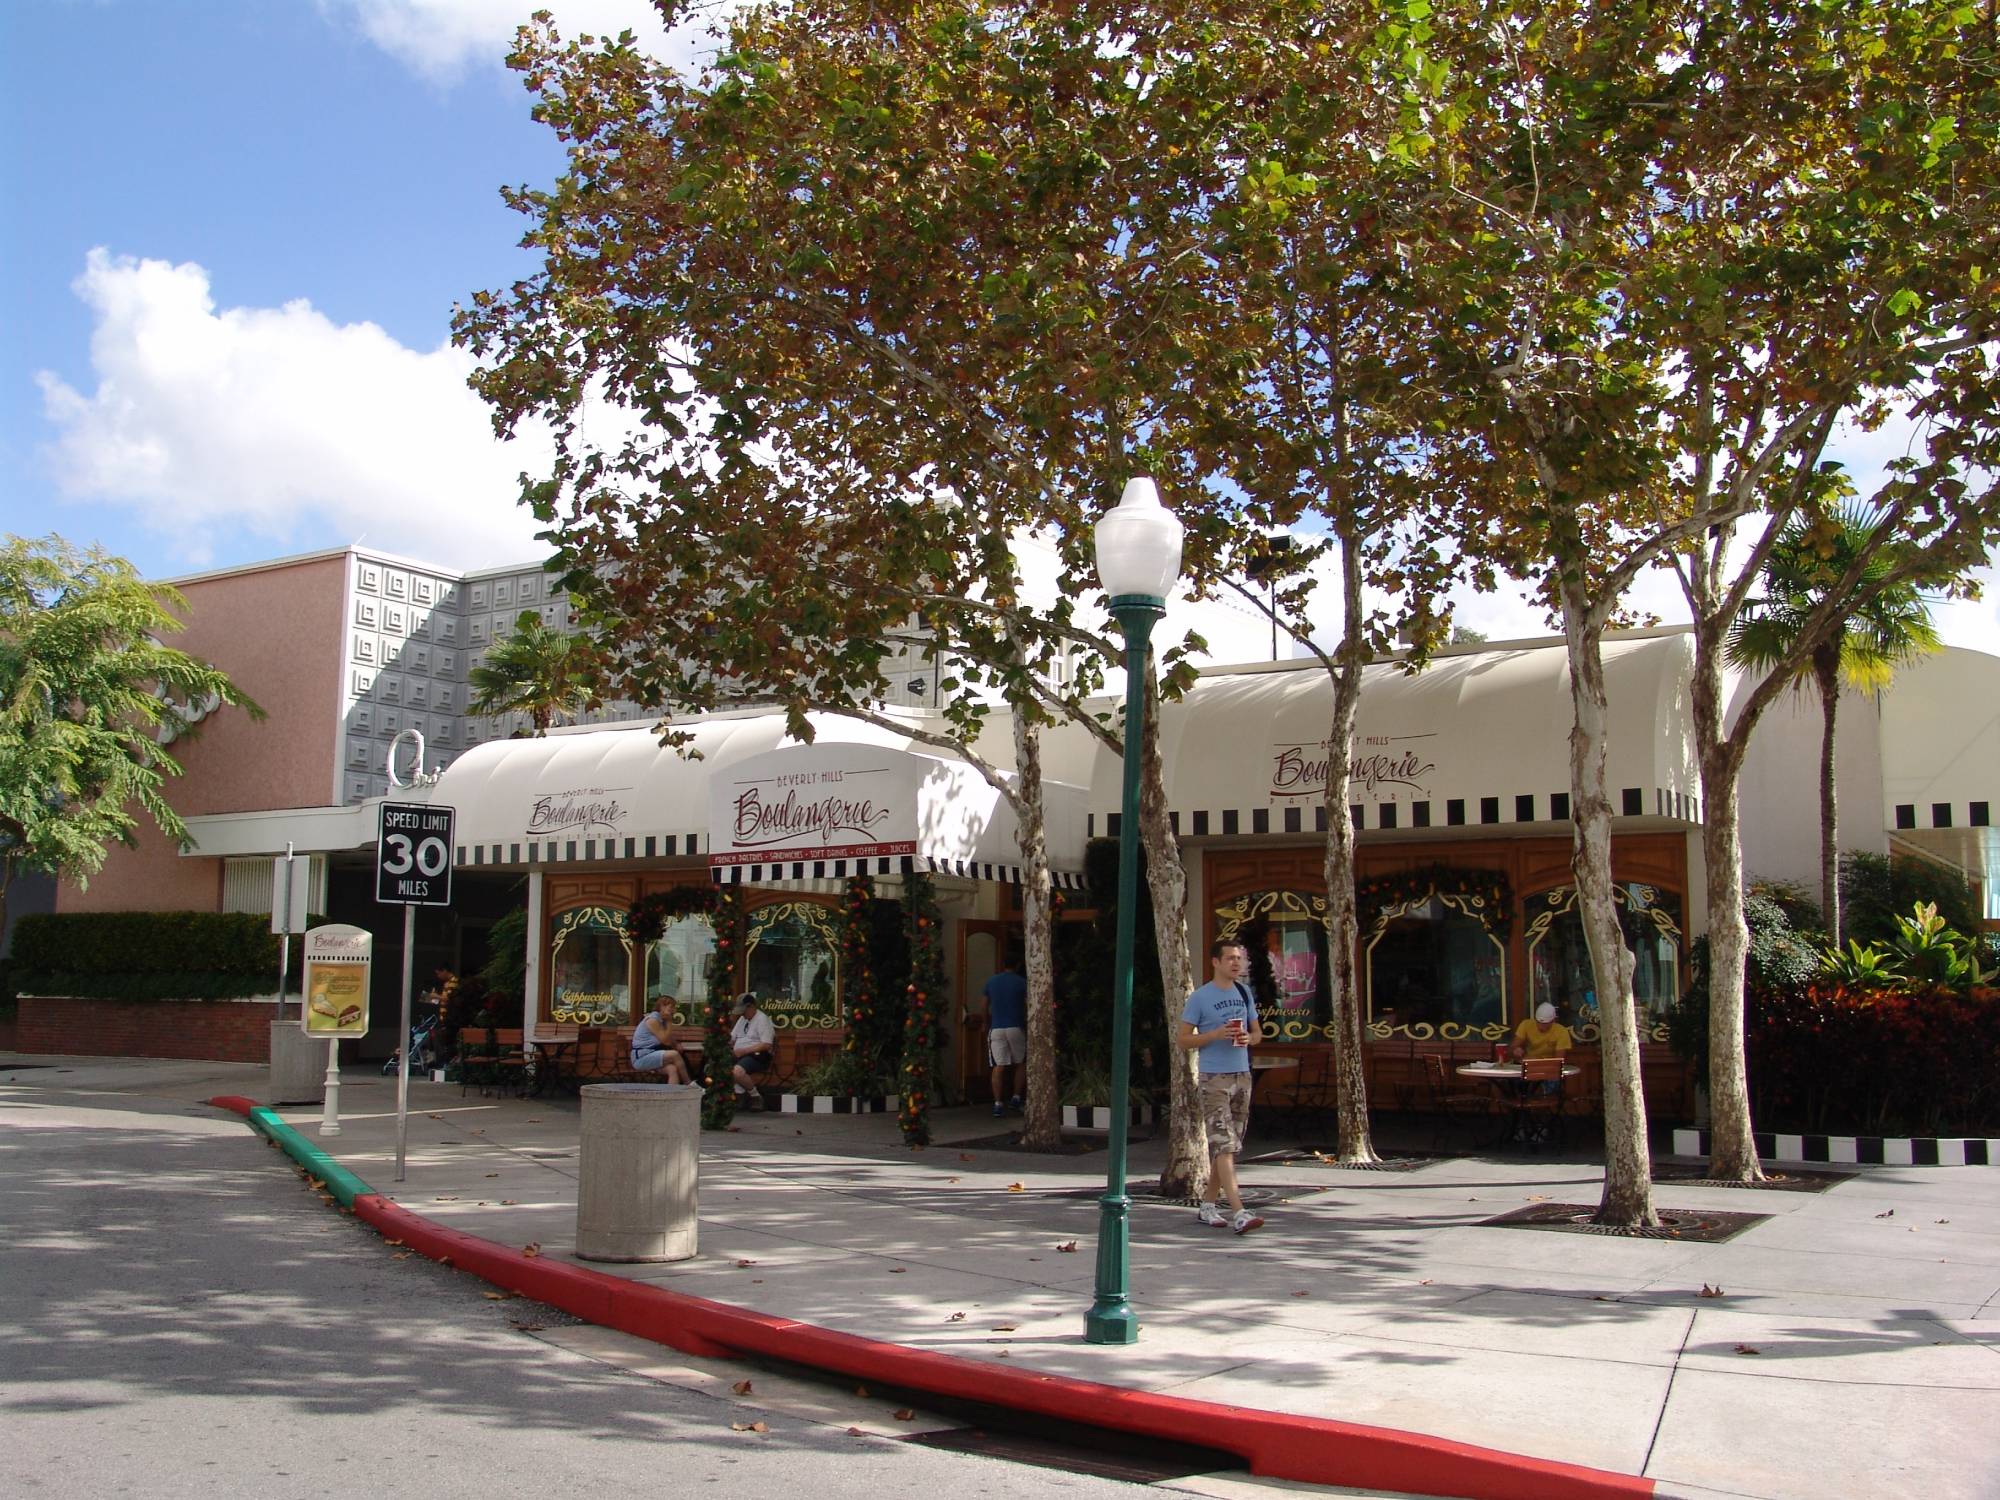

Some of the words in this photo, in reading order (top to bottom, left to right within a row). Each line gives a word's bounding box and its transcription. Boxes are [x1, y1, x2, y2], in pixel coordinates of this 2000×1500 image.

[1321, 736, 1363, 750] BELY
[1366, 736, 1389, 747] HILLS
[777, 774, 817, 787] BEVERLY
[821, 771, 844, 784] HILLS
[385, 811, 419, 829] SPEED
[422, 814, 449, 831] LIMIT
[529, 796, 628, 832] Boulangerie
[732, 787, 889, 845] Boulangerie
[383, 833, 448, 877] 30
[769, 850, 804, 861] SANDWICHES
[810, 849, 824, 859] SOFT
[856, 846, 879, 857] COFFEE
[890, 844, 911, 855] JUICES
[398, 879, 429, 897] MILES
[561, 990, 614, 1006] Cappuccino
[760, 997, 821, 1011] Sandwiches
